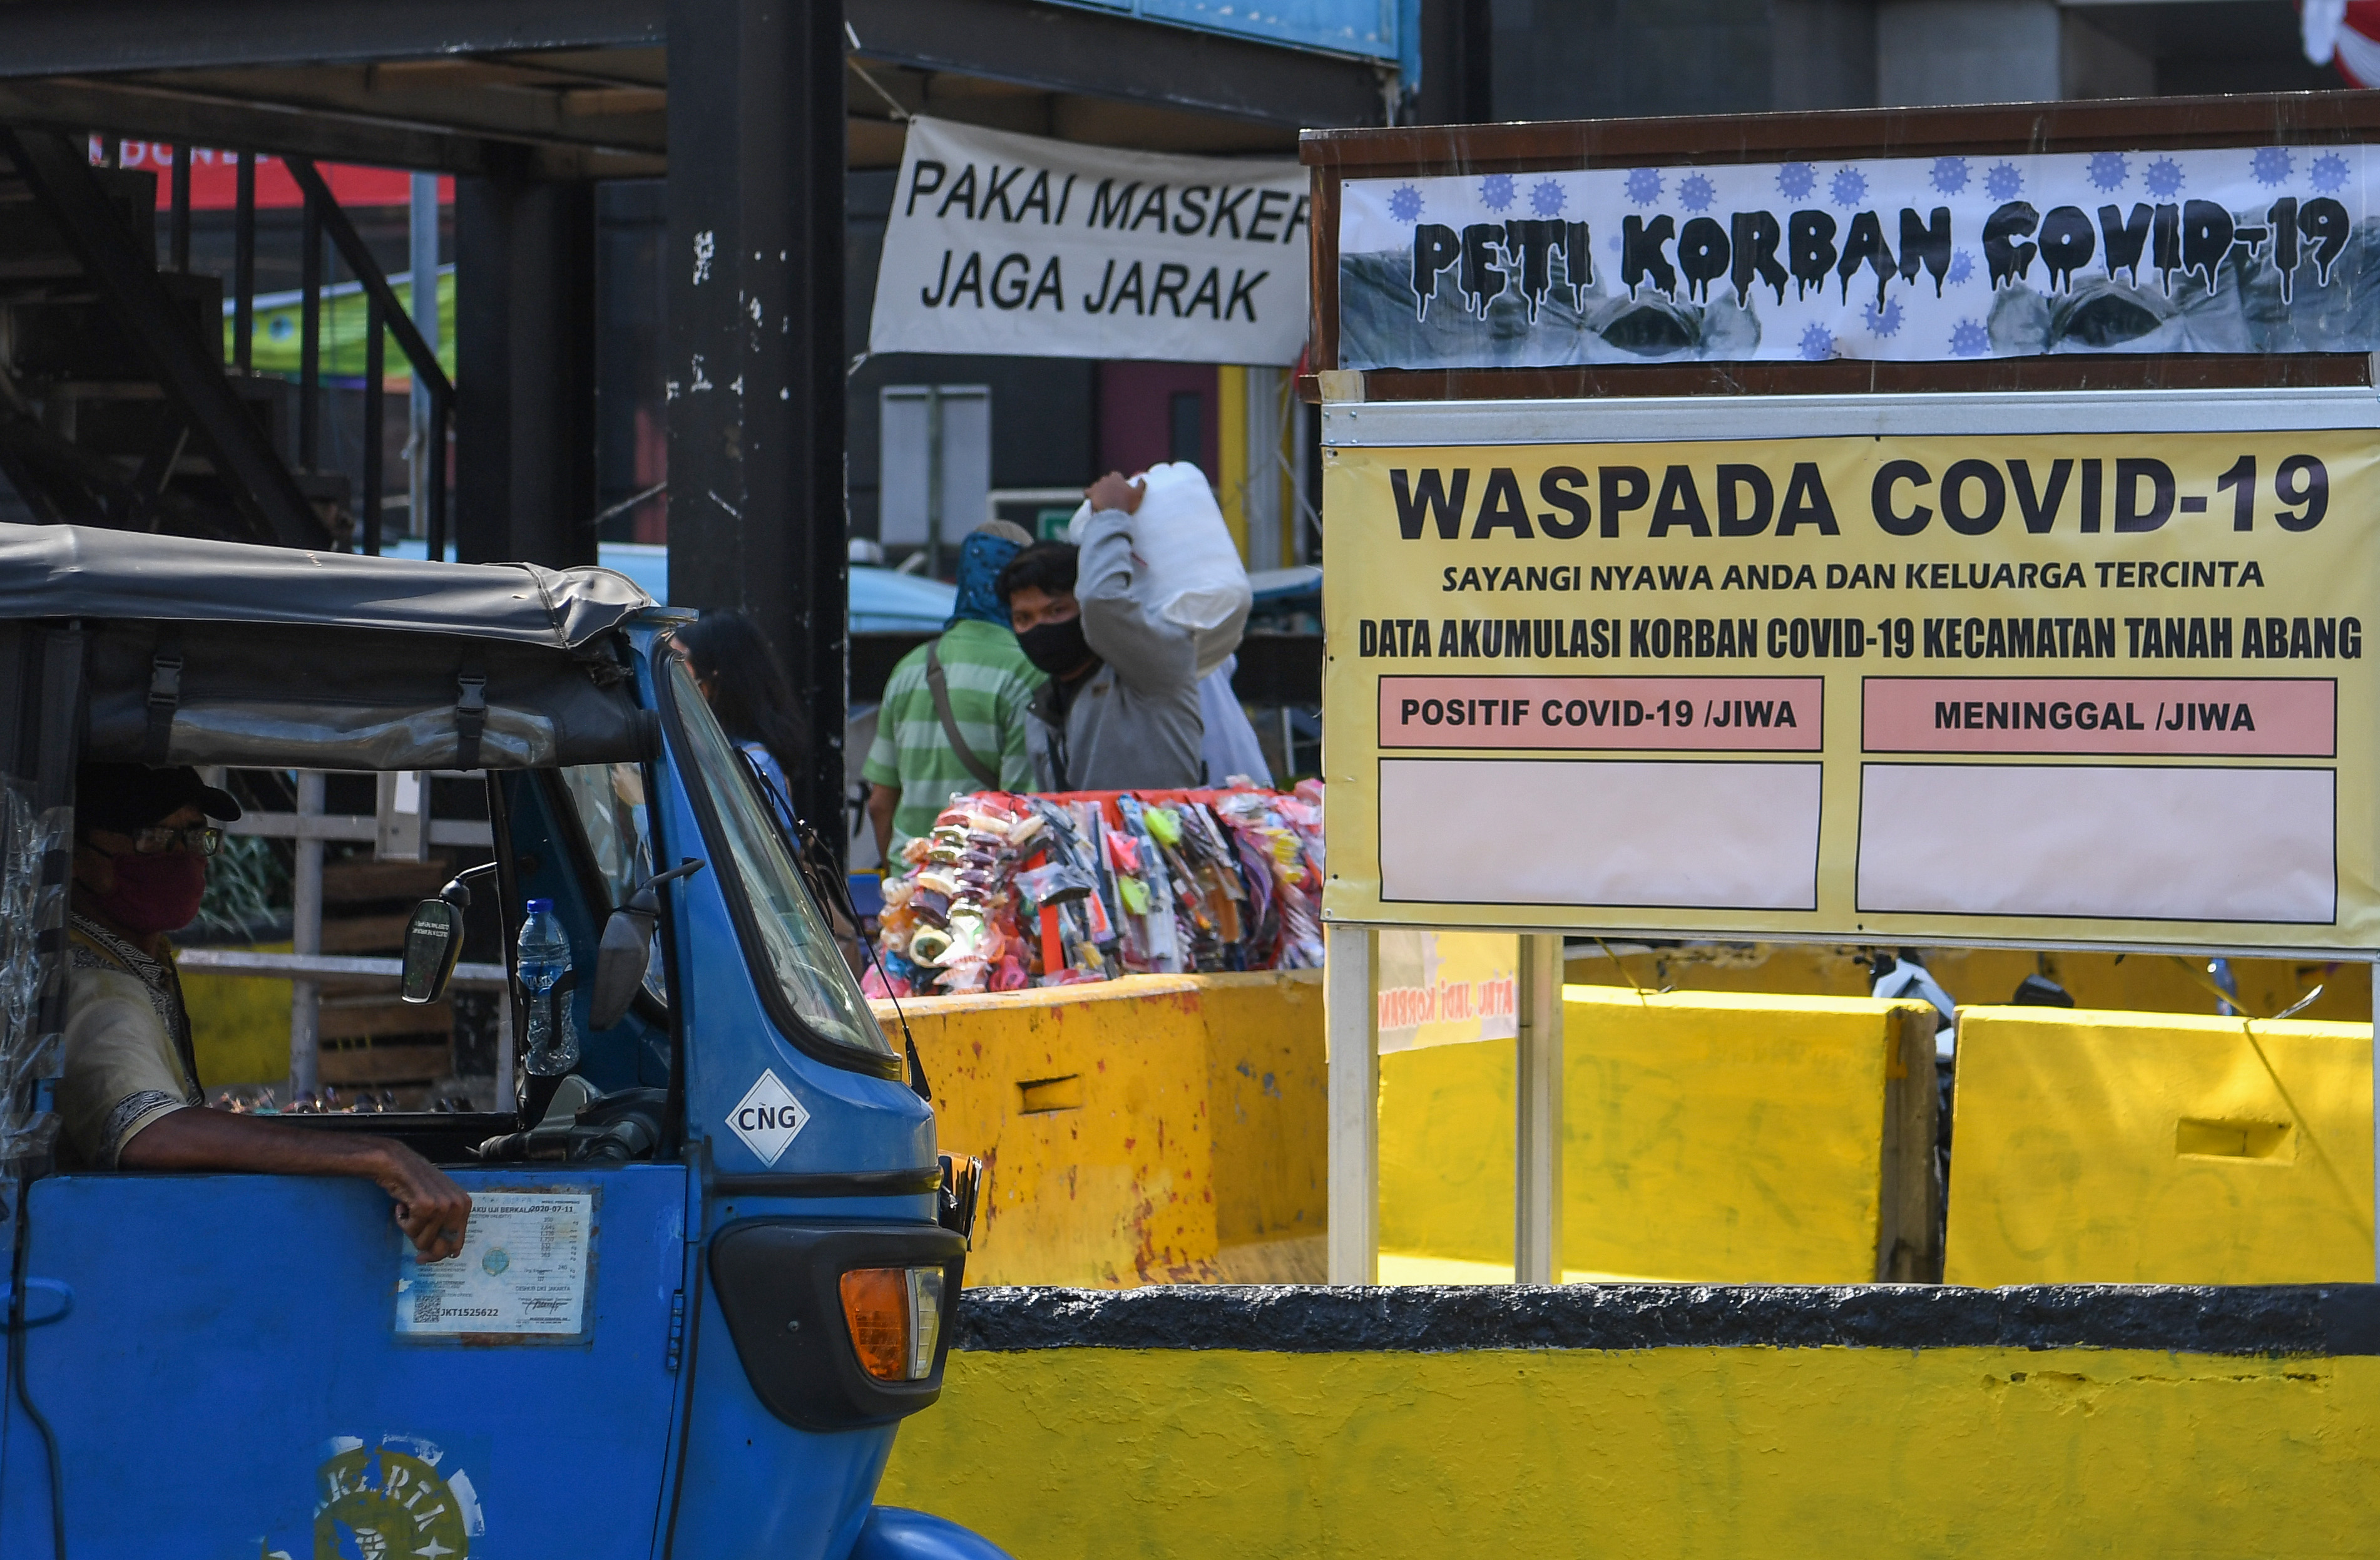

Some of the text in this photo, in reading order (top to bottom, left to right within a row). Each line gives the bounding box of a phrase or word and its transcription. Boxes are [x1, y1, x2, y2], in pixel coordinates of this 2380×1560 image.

[907, 160, 1077, 225] PAKAI
[1411, 197, 2351, 324] PETI KORBAN COVID-19
[921, 250, 1269, 322] JAGA JARAK
[1390, 454, 2330, 540] WASPADA COVID-19
[1442, 560, 2265, 592] SAYANGI NYAWA ANDA DAN KELUARGA TERCINTA
[1360, 616, 2362, 660] DATA AKUMULASI KORBAN COVID-19 KECAMATAN TANAH ABANG
[1401, 699, 1797, 728] POSITIF COVID-19 /JIWA
[1934, 701, 2256, 732] MENINGGAL /JIWA
[737, 1106, 795, 1131] CNG
[531, 1205, 573, 1213] 2020-07-11
[440, 1308, 499, 1317] JKT1525622
